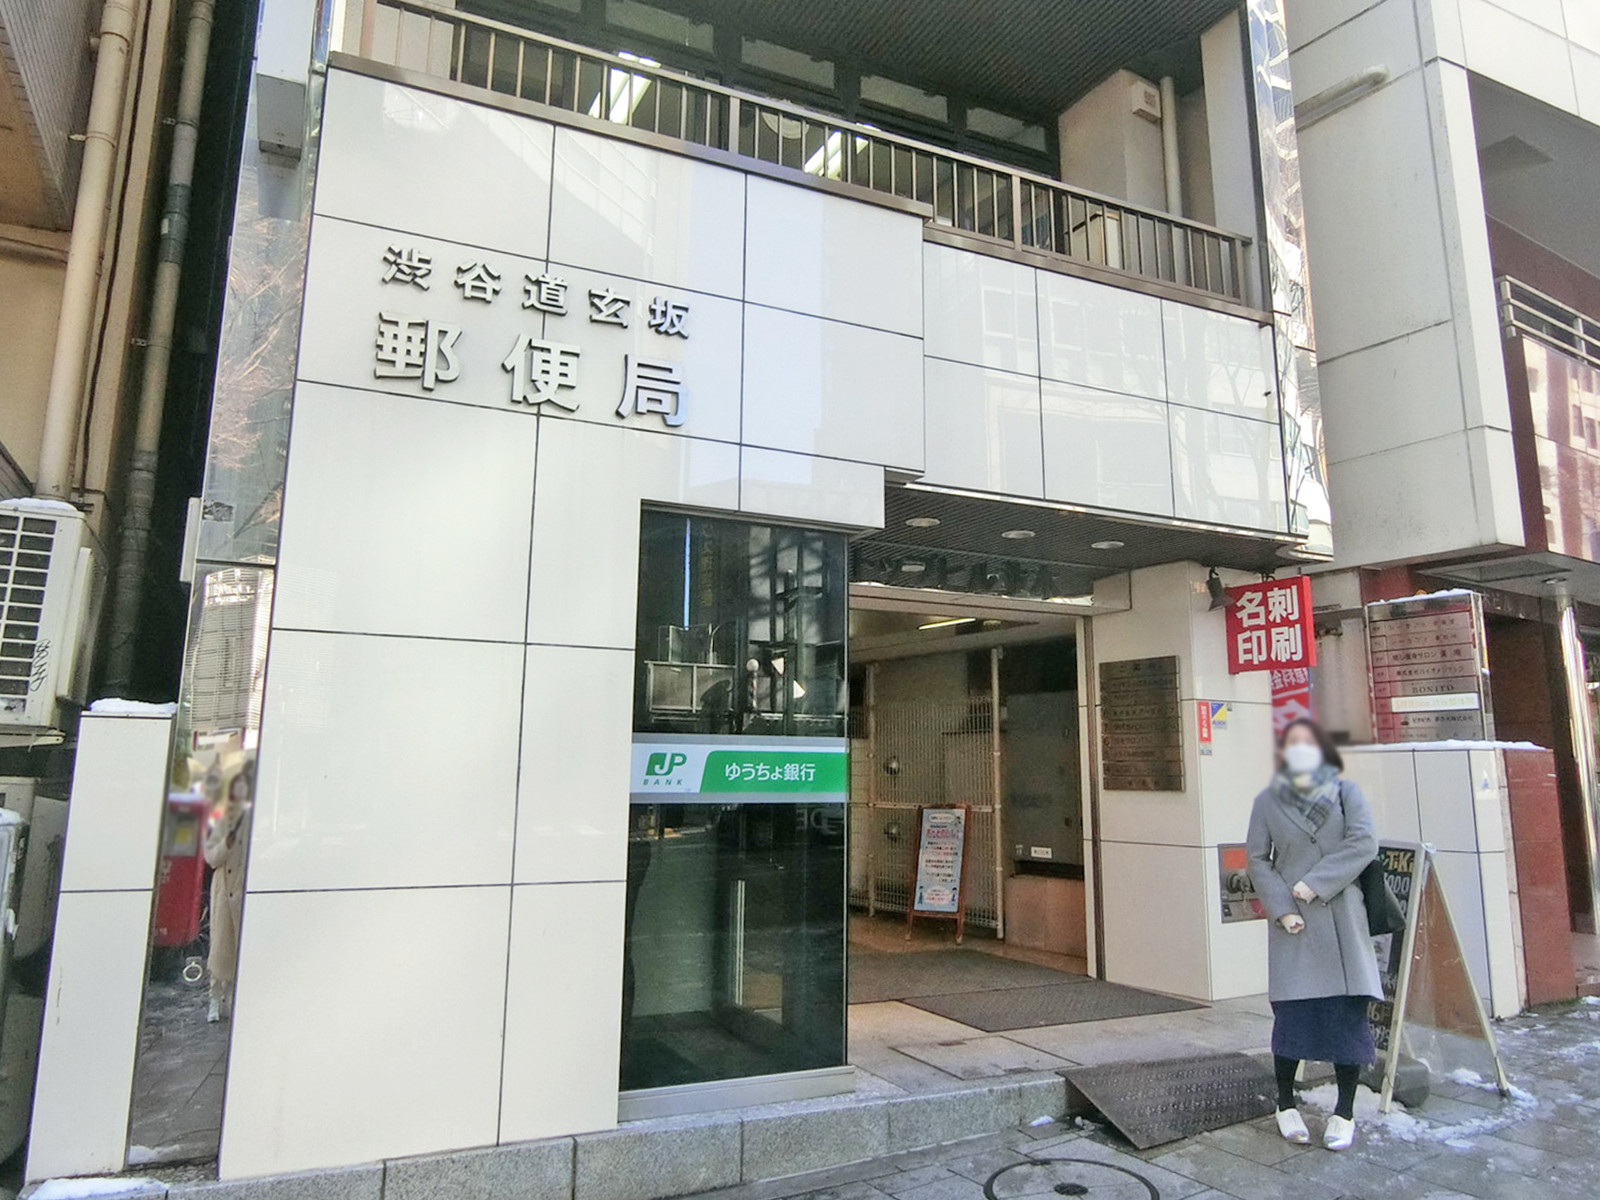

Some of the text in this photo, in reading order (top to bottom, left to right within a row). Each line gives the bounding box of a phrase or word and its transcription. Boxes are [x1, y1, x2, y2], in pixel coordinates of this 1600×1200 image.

[382, 244, 689, 339] 渋谷道玄坂
[374, 311, 689, 427] 郵便局
[1235, 585, 1299, 628] 名刺
[1237, 624, 1303, 665] 印刷
[645, 752, 687, 776] JP
[724, 763, 816, 782] ゆうちょ銀行
